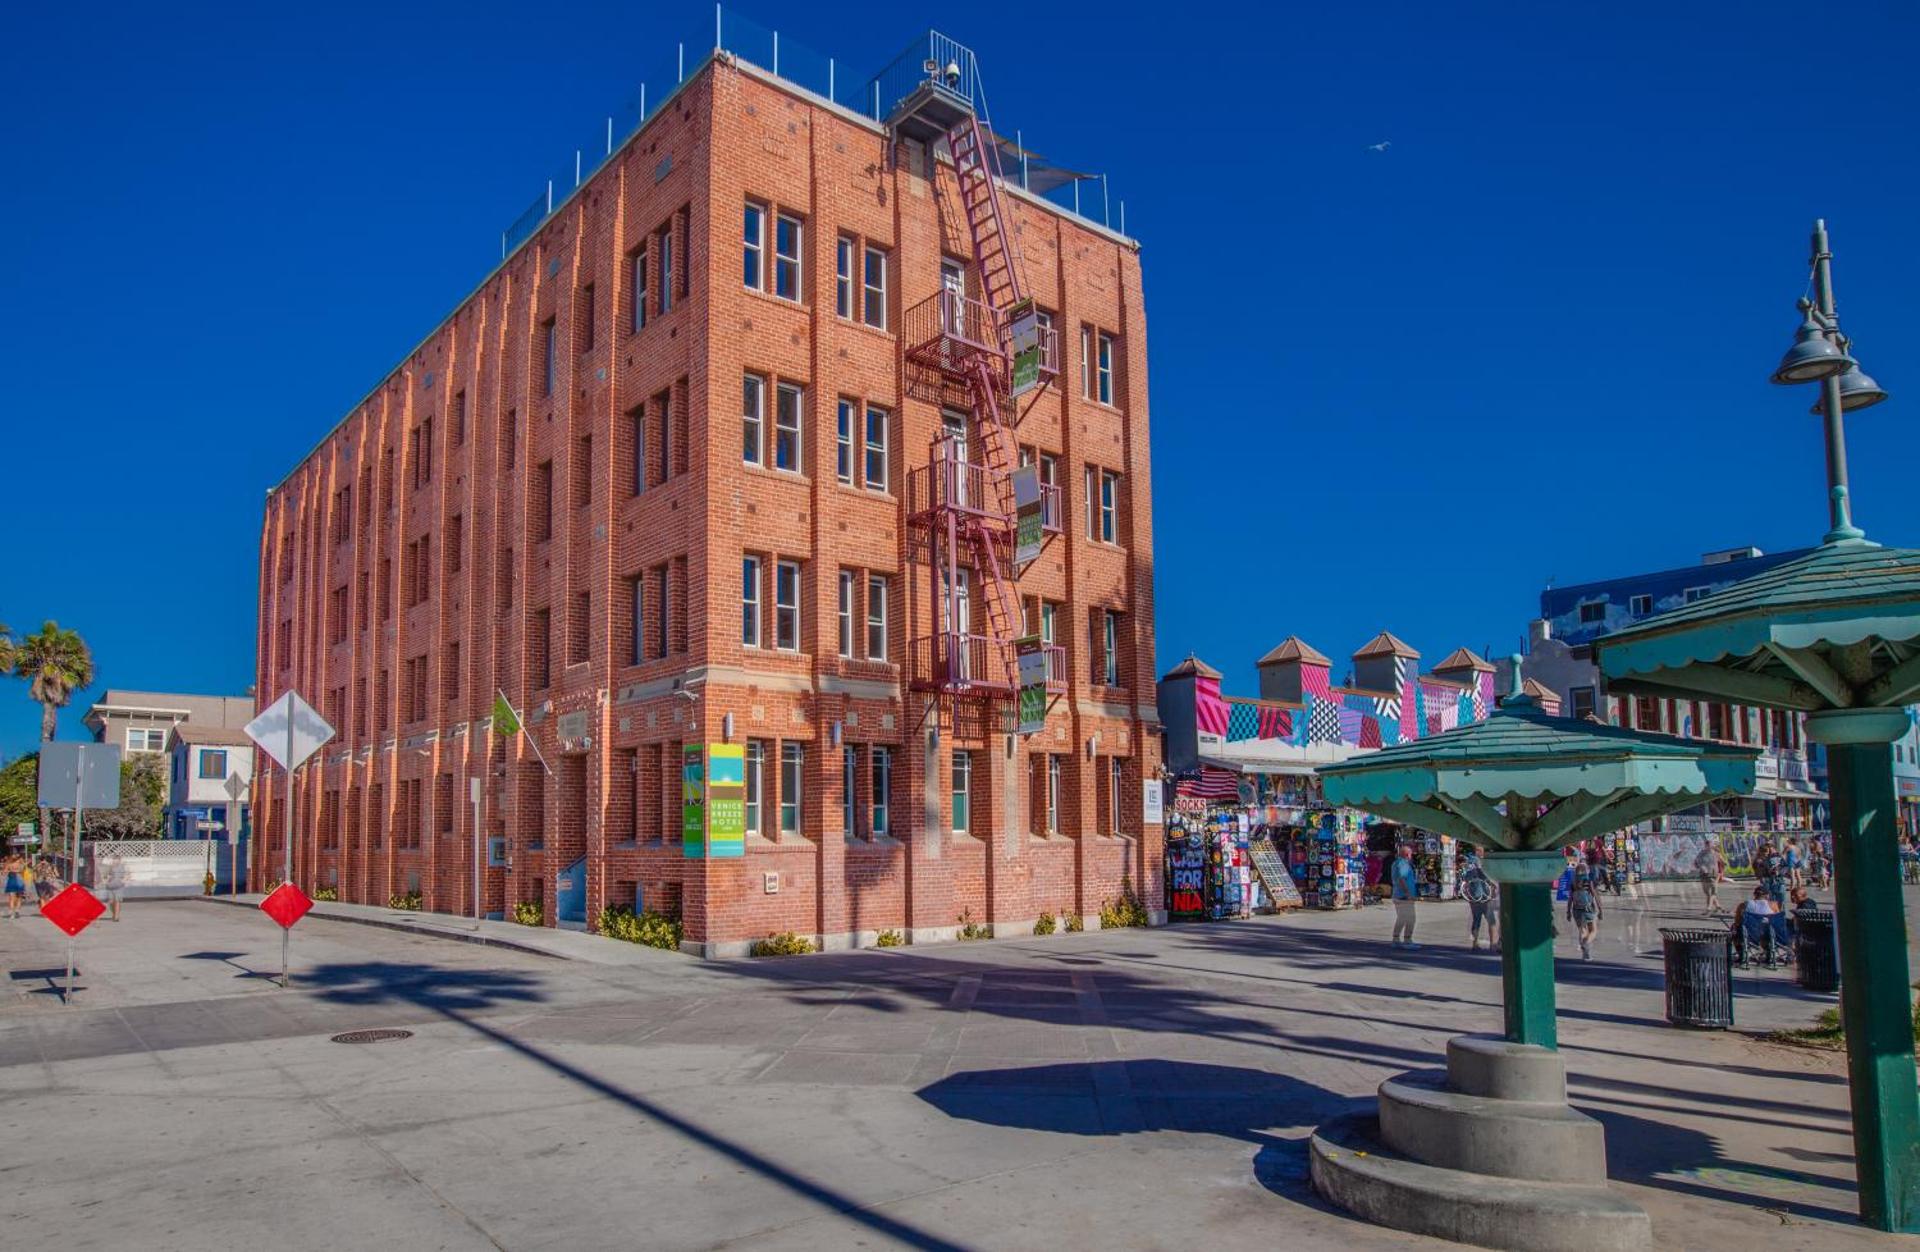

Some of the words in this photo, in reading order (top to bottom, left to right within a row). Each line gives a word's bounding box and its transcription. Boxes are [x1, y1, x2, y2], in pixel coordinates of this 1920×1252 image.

[1175, 799, 1206, 811] SOCKS
[1173, 869, 1203, 889] FOR
[1173, 891, 1203, 912] NIA
